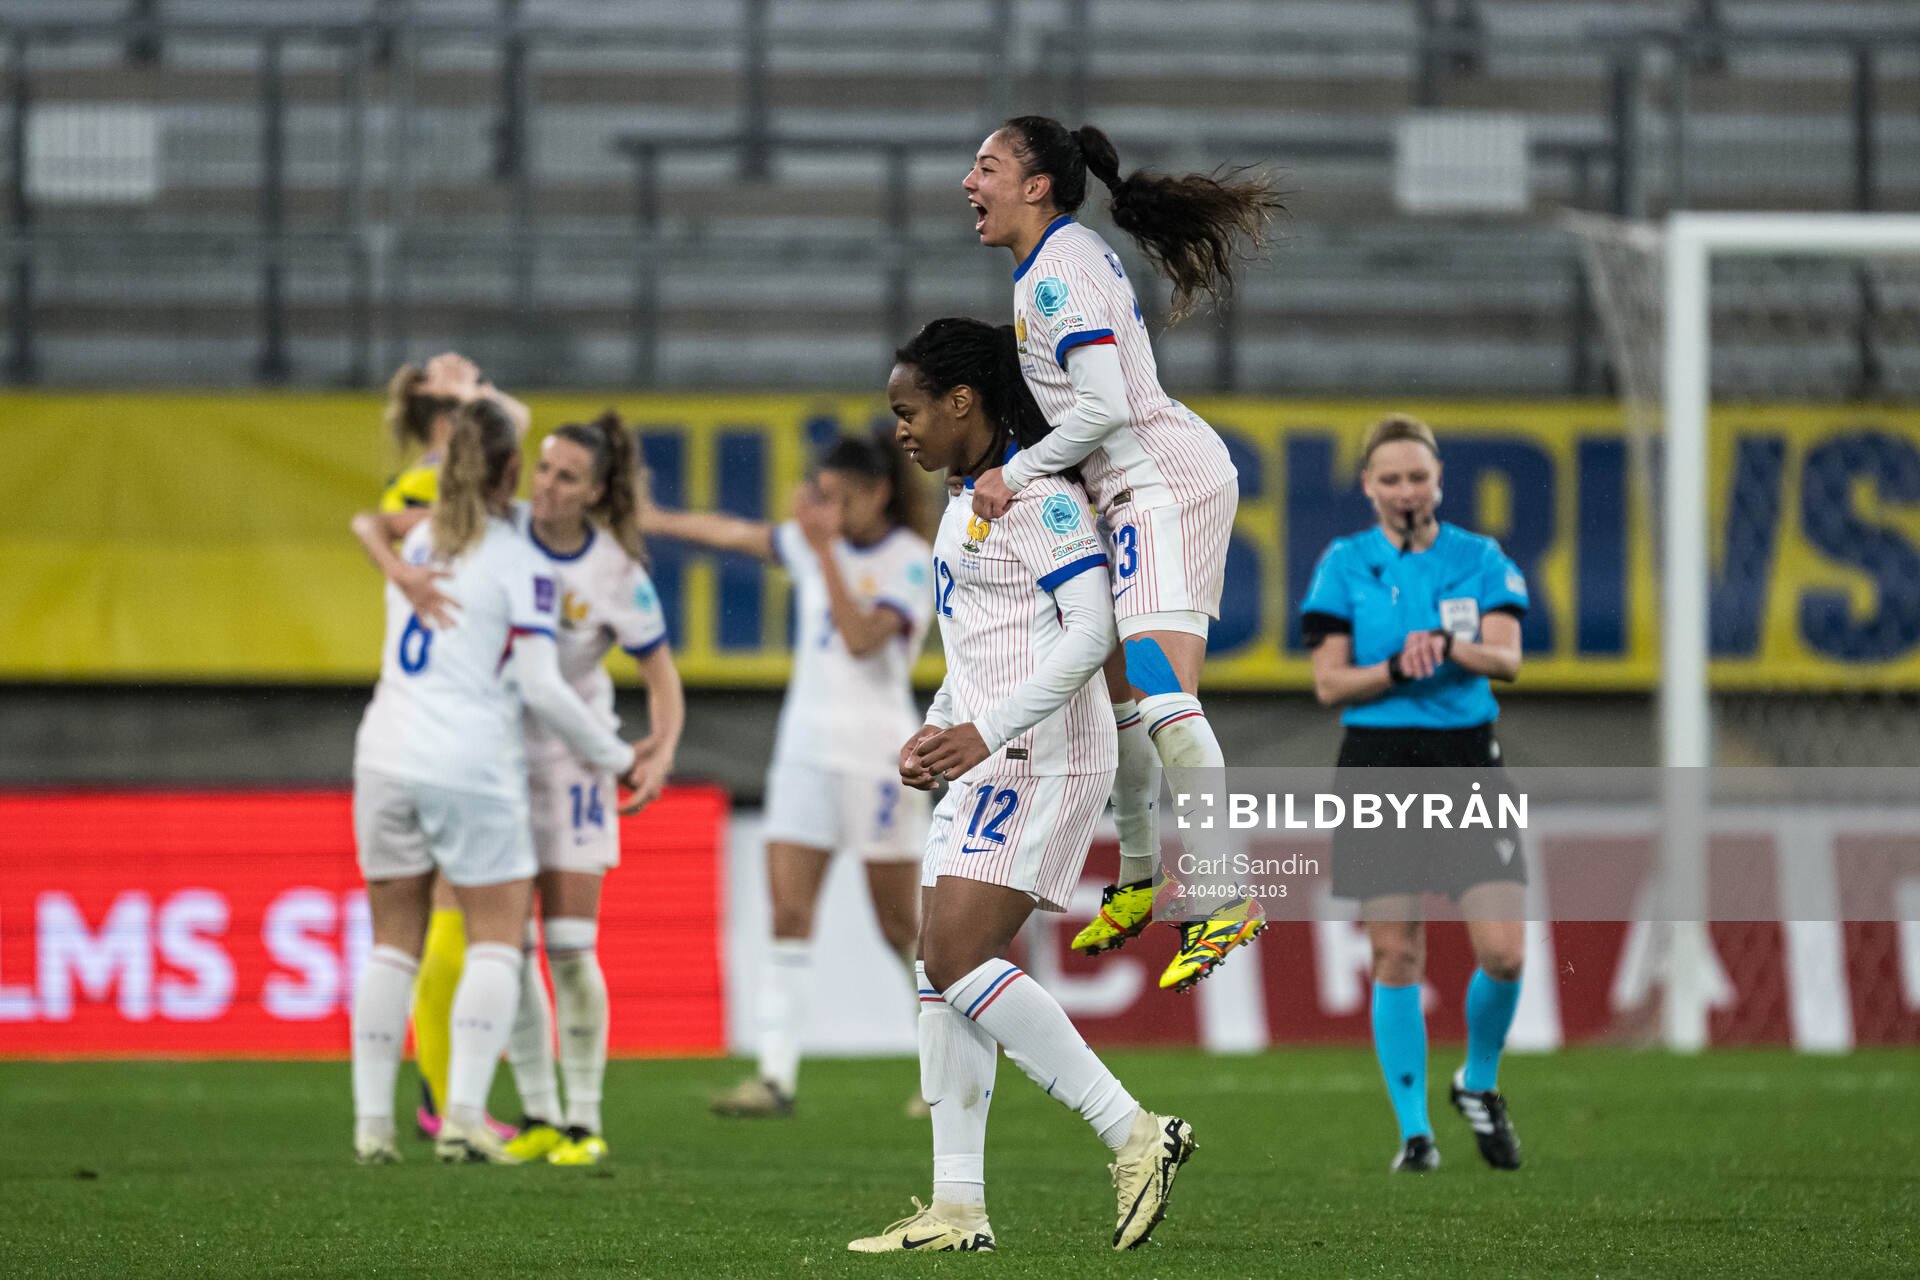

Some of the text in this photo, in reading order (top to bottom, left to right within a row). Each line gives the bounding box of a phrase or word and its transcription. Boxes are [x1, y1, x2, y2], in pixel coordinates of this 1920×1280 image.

[1052, 538, 1097, 559] FOUNDATION
[933, 556, 954, 618] 12
[569, 784, 605, 829] 14
[967, 784, 1019, 846] 12
[0, 888, 237, 1022] MS
